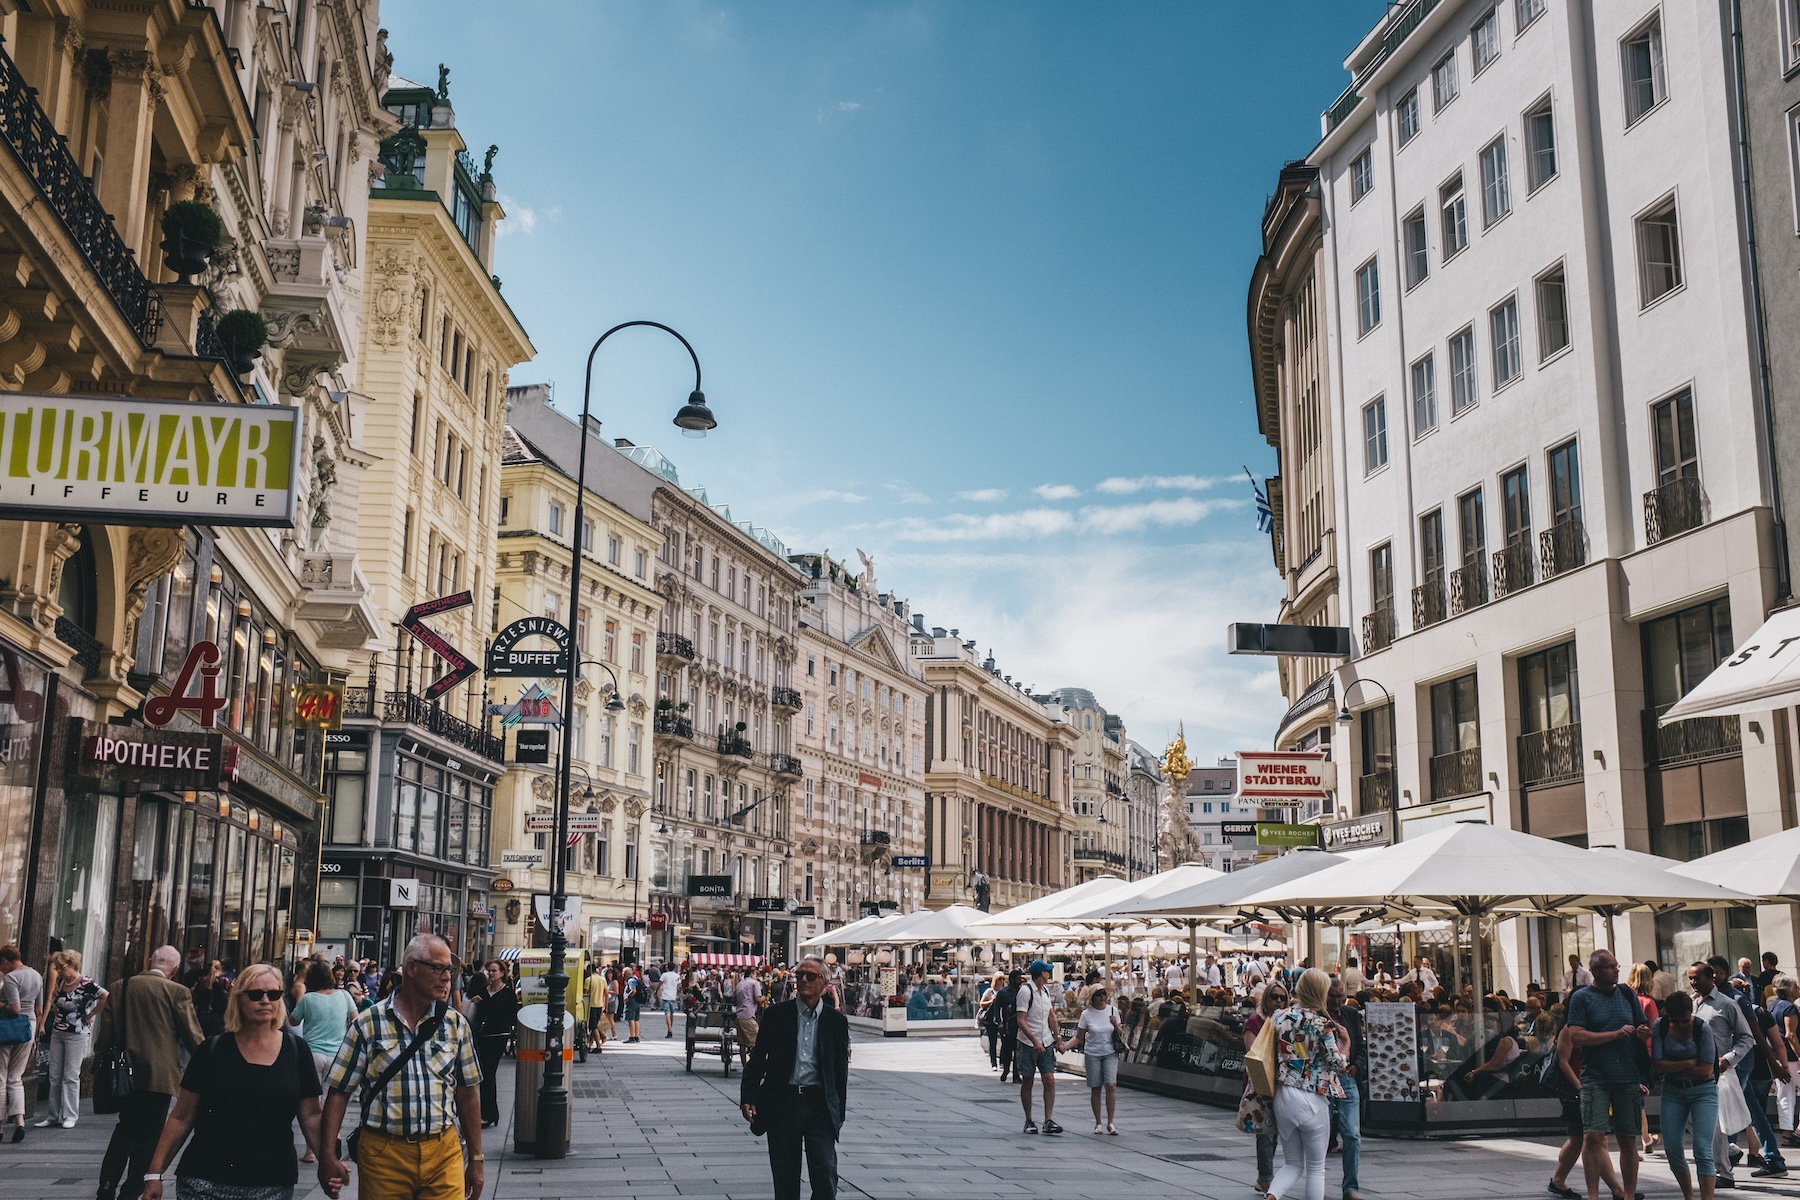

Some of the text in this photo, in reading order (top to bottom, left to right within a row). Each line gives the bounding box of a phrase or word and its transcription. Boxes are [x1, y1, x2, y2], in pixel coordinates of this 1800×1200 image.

[0, 484, 265, 506] IFFEURE
[413, 593, 467, 613] DISCOTHEQUE
[410, 624, 466, 671] FLEDERMAUS
[509, 654, 560, 664] BUFFET
[442, 673, 457, 686] BAR
[297, 694, 338, 719] H&M
[94, 736, 212, 771] APOTHEKE
[1257, 764, 1307, 774] WIENER
[1350, 822, 1381, 837] ROCHER
[897, 858, 925, 866] Berlitz
